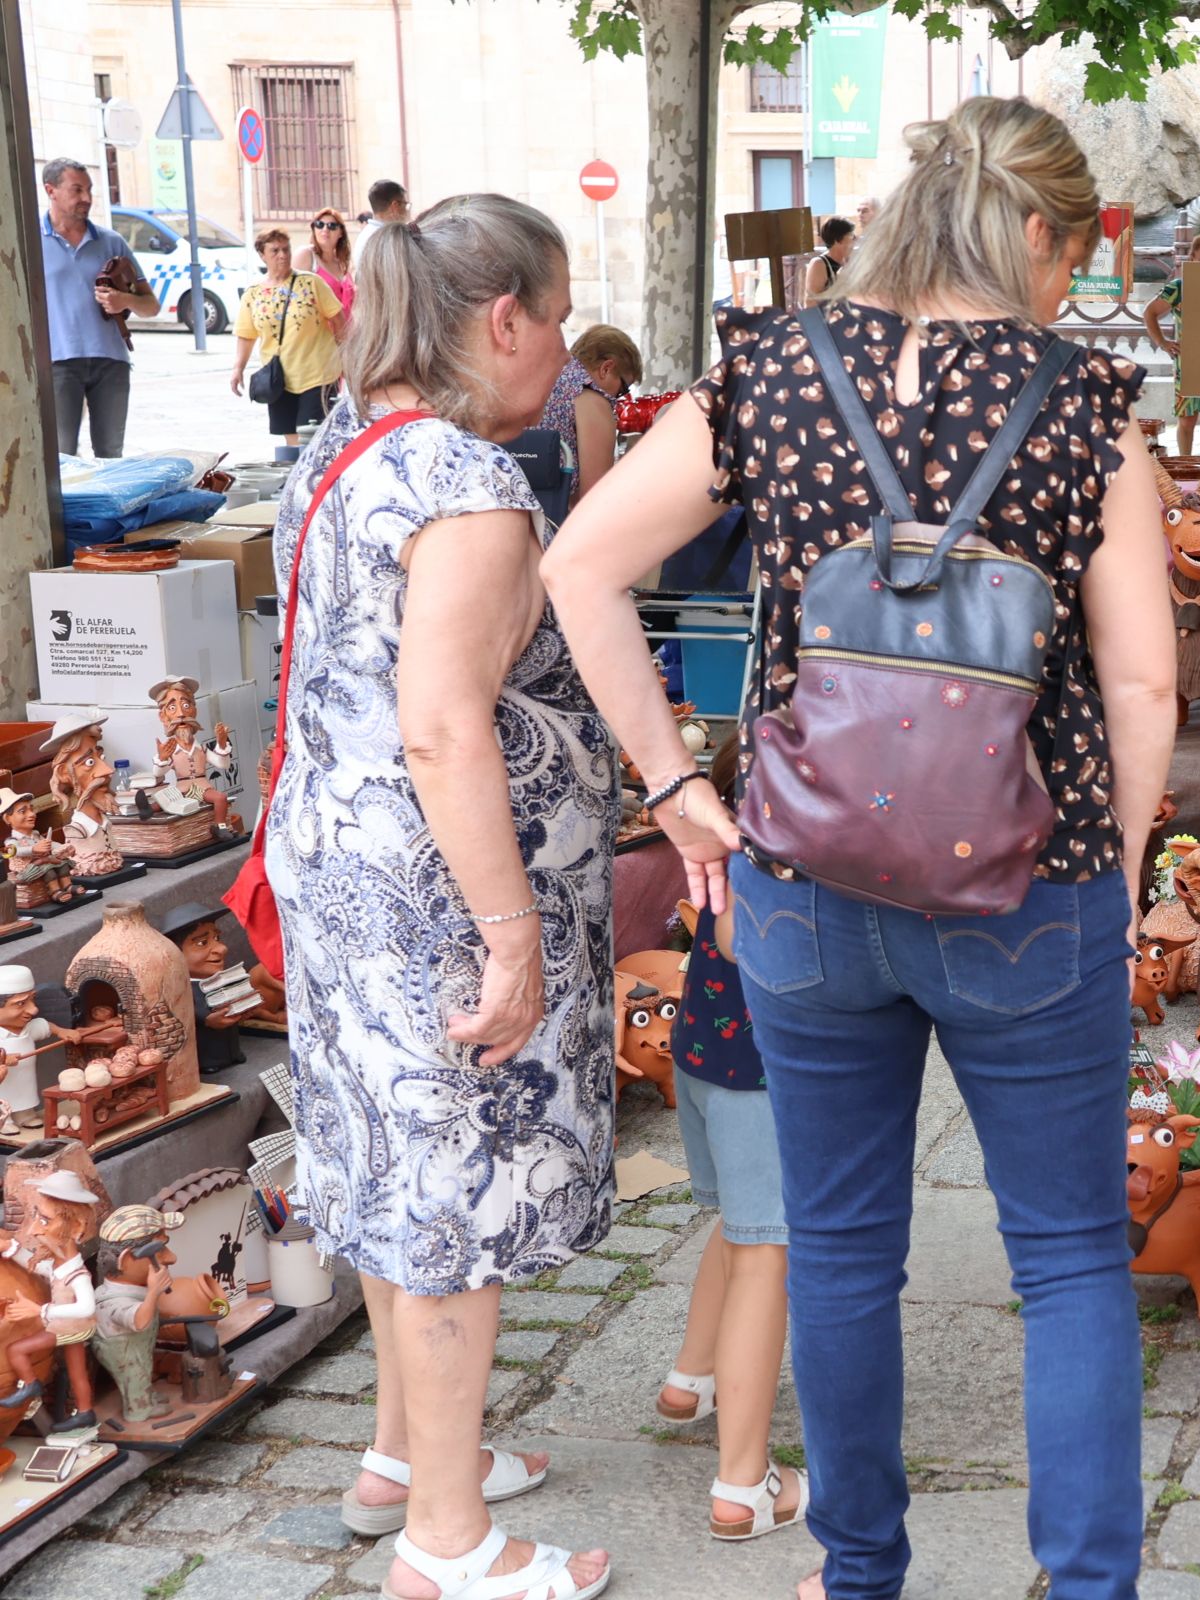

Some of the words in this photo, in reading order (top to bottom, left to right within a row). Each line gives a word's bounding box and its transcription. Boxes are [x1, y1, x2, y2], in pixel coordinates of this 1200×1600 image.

[1077, 281, 1095, 289] CAJA
[1096, 282, 1120, 290] RURAL
[87, 618, 113, 627] ALFAR
